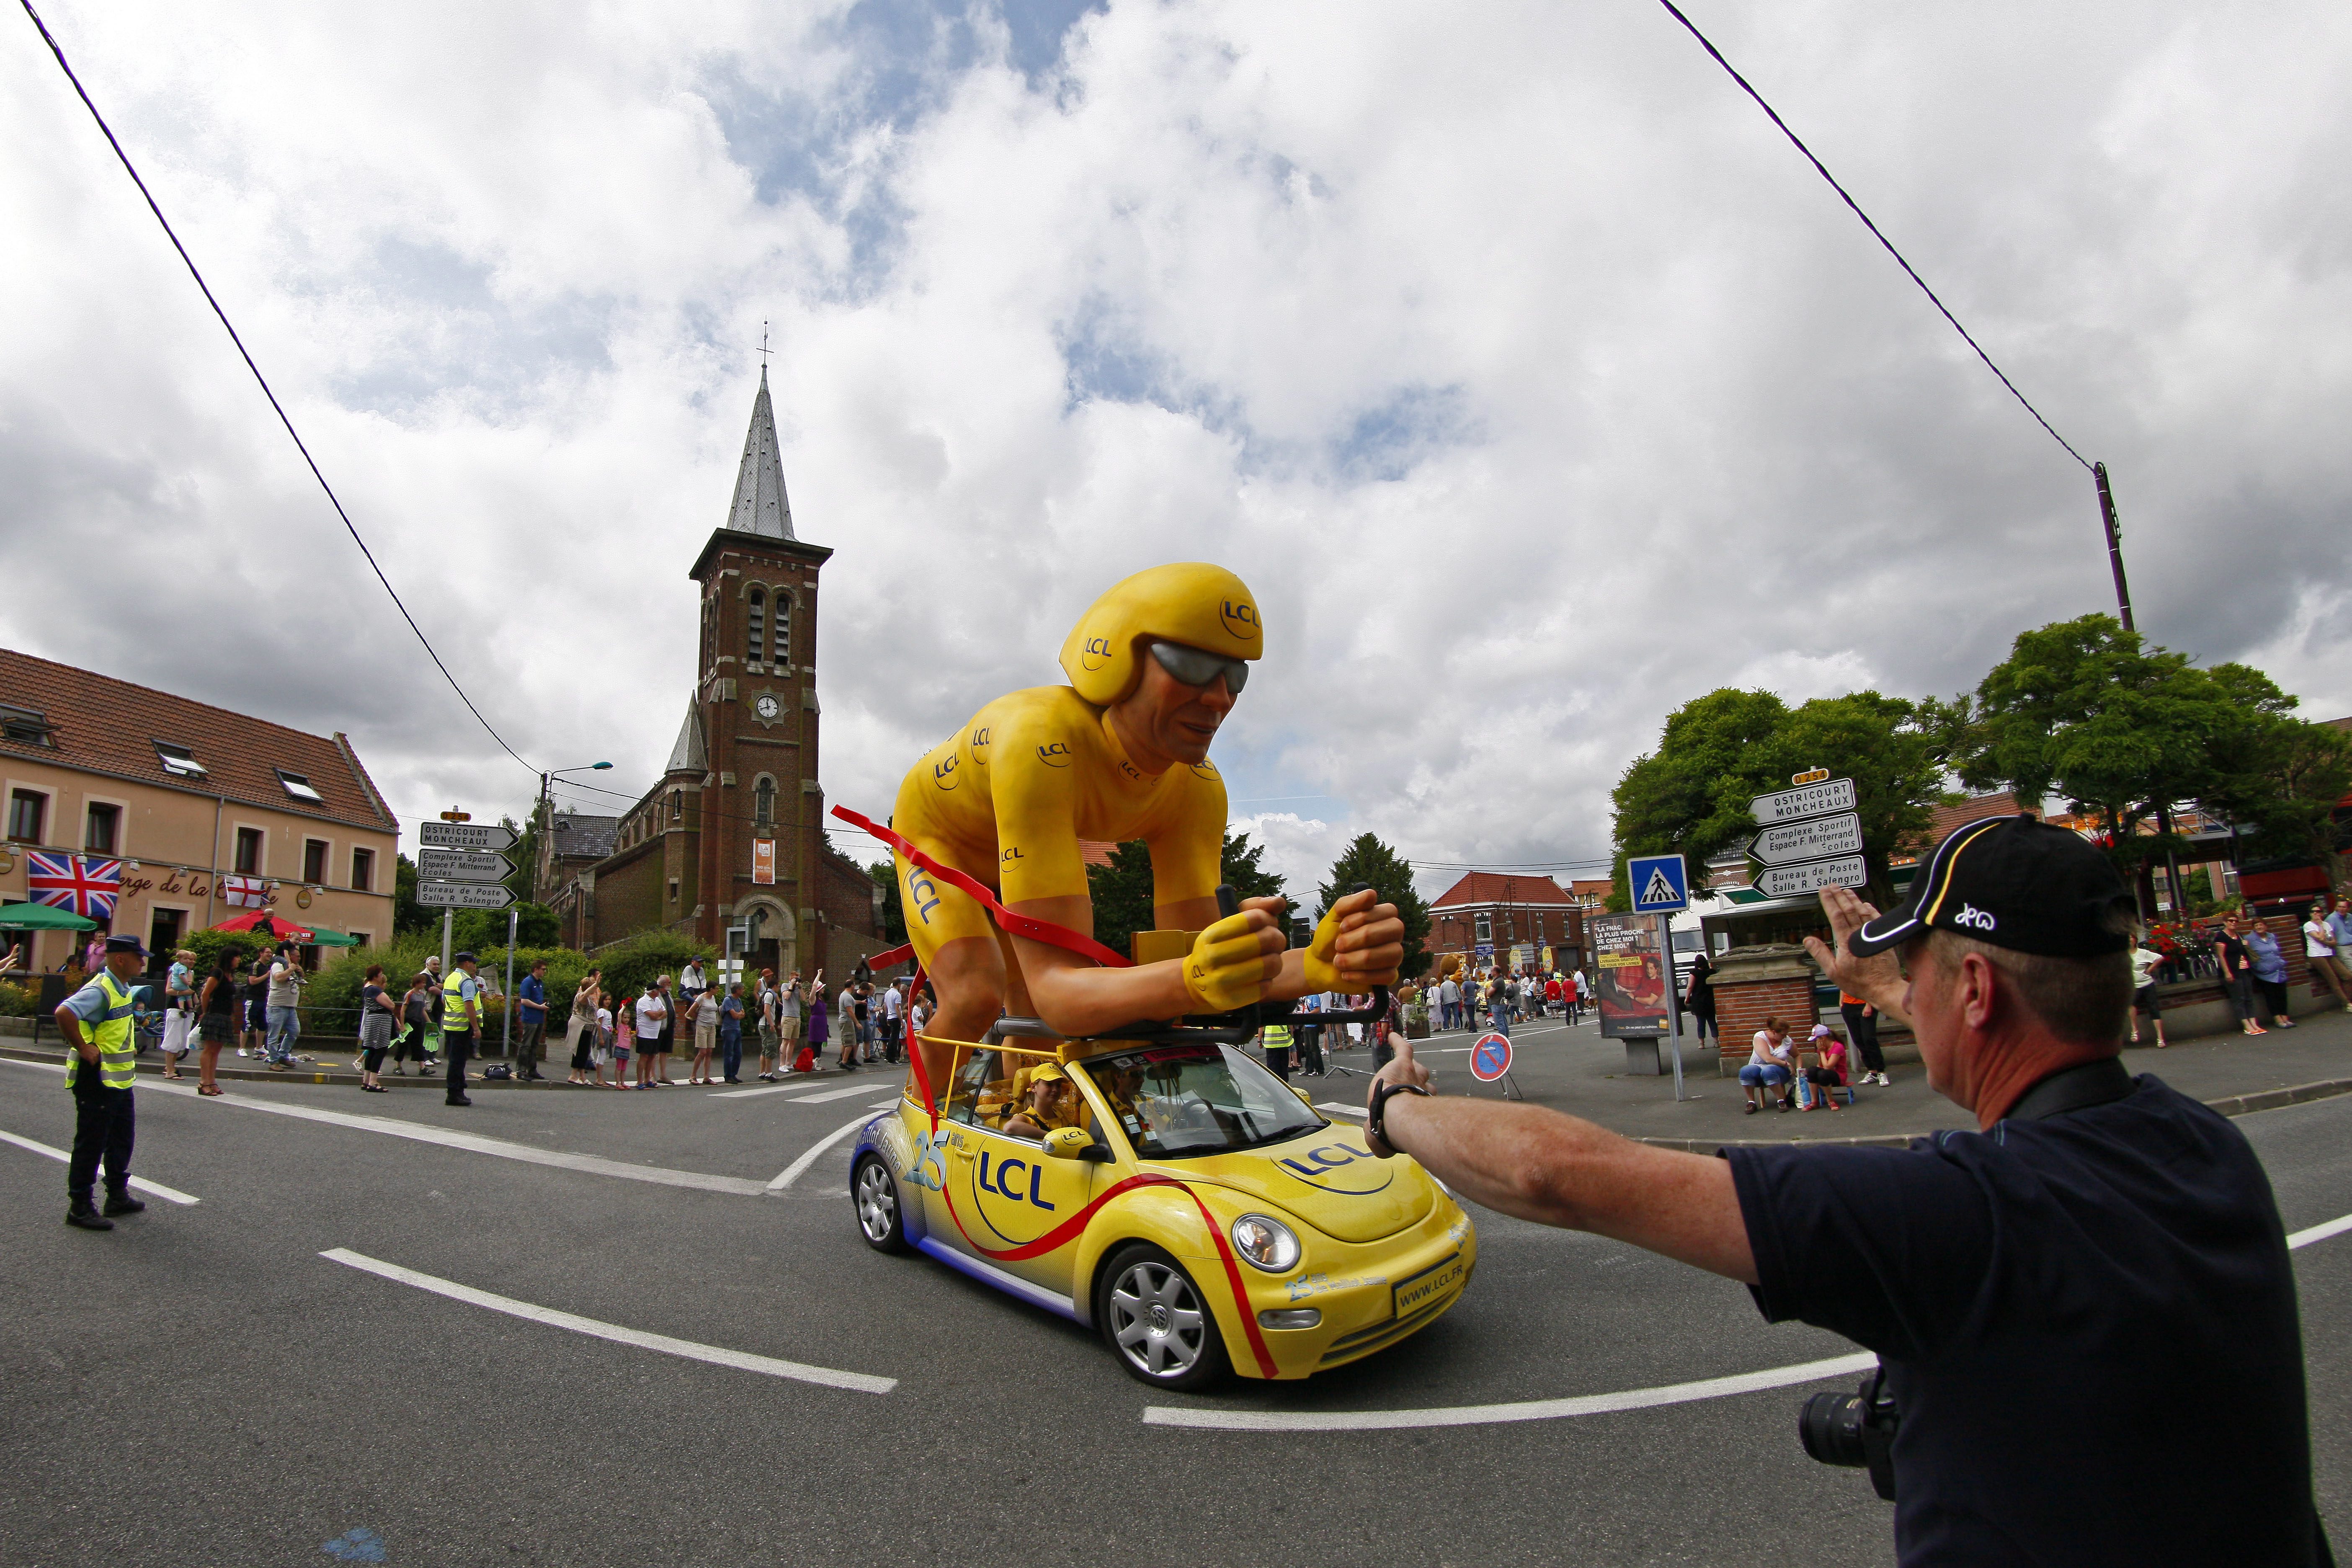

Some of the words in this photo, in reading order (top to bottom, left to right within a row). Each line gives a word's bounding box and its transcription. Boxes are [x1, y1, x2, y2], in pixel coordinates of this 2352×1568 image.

[1225, 601, 1260, 628] LCL
[1085, 637, 1112, 657] LCL
[973, 727, 990, 746] LCL
[1039, 743, 1072, 756] LCL
[935, 752, 960, 779] LCL
[1122, 761, 1140, 781] LCL
[1805, 771, 1826, 782] 254
[1774, 784, 1847, 806] OSTRICOURT
[1776, 796, 1849, 817] MONCHEAUX
[425, 826, 489, 837] OSTRICOURT
[1769, 827, 1812, 841] Complexe
[1818, 818, 1852, 833] Sportif
[425, 835, 487, 846] MONCHEAUX
[1770, 840, 1797, 852] Espace
[1800, 837, 1806, 846] F.
[1809, 829, 1853, 844] Mitterrand
[423, 852, 463, 861] Complexe
[467, 855, 496, 864] Sportif
[423, 860, 451, 869] Espace
[1001, 847, 1024, 862] LCL
[423, 867, 452, 876] Écoles
[1772, 870, 1806, 882] Bureau
[1813, 867, 1823, 876] de
[1829, 863, 1858, 874] Poste
[160, 873, 183, 892] de
[188, 876, 209, 896] la
[423, 885, 454, 893] Bureau
[1773, 883, 1795, 892] Salle
[1802, 880, 1810, 889] R.
[1817, 875, 1859, 886] Salengro
[463, 896, 500, 905] Salengro
[909, 867, 941, 925] LCL
[1063, 1130, 1085, 1140] LCL
[879, 1132, 901, 1173] Jaune
[901, 1130, 951, 1191] 25
[951, 1132, 964, 1148] ans
[1279, 1142, 1376, 1176] LCL
[979, 1151, 1055, 1212] LCL
[1285, 1274, 1314, 1302] 25
[1311, 1271, 1327, 1283] ans
[1400, 1264, 1463, 1307] WWW.LCL.FR
